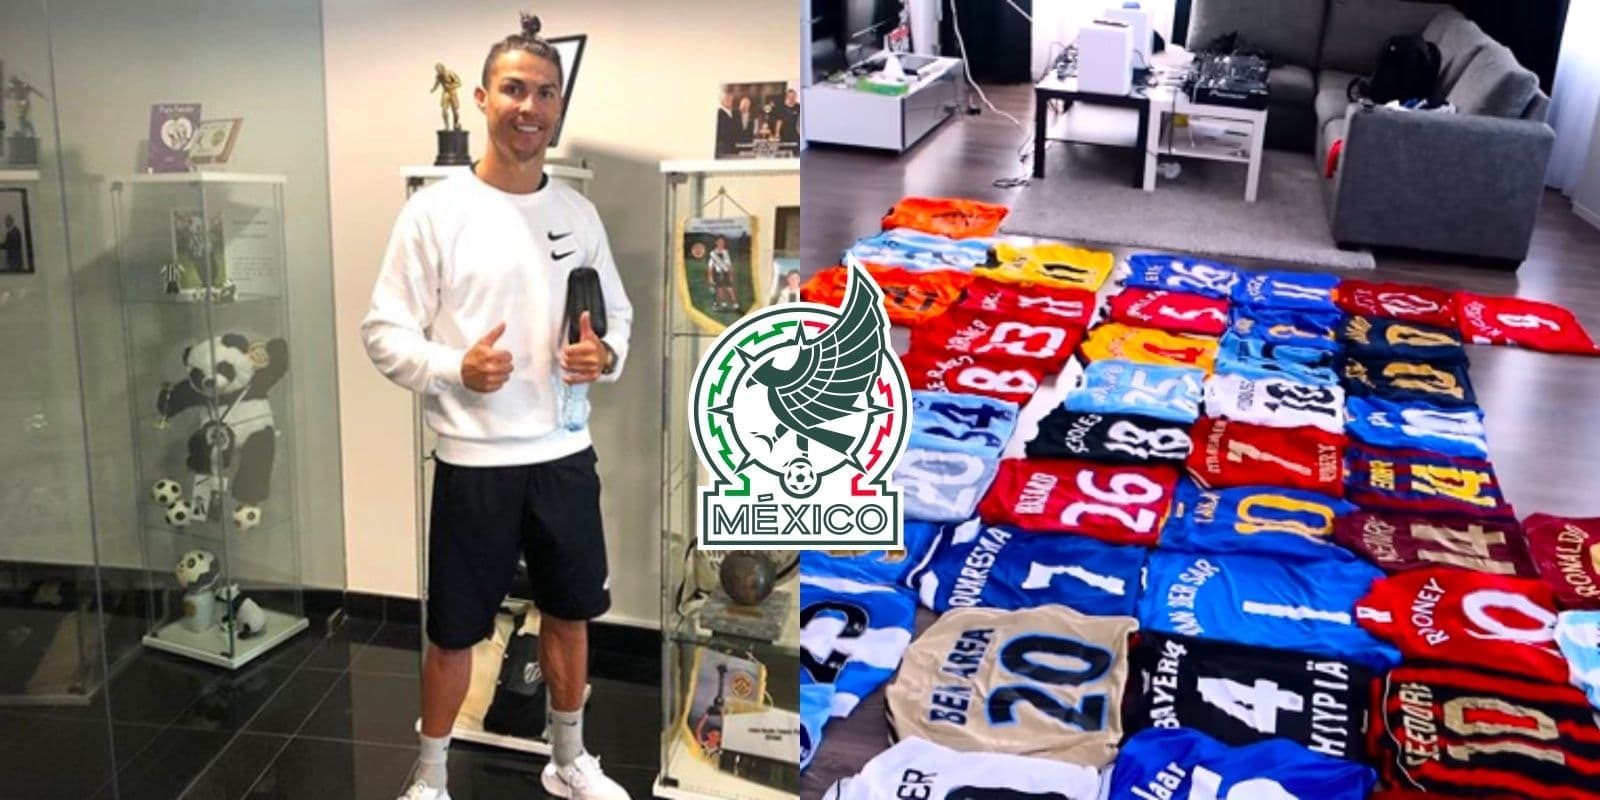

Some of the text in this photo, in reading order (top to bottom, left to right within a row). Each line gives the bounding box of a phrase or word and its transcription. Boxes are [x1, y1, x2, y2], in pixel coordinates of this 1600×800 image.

[956, 365, 1038, 394] 8
[1225, 438, 1313, 478] 7
[1060, 469, 1164, 534] 26
[1178, 558, 1221, 590] SAR
[1410, 523, 1517, 575] 14
[1020, 560, 1127, 596] 7
[1166, 582, 1196, 611] DER
[1242, 599, 1352, 625] 1
[1462, 588, 1566, 658] 0
[929, 677, 973, 728] BEN
[984, 632, 1113, 732] 20
[1197, 677, 1304, 734] 4
[1443, 696, 1567, 766] 10
